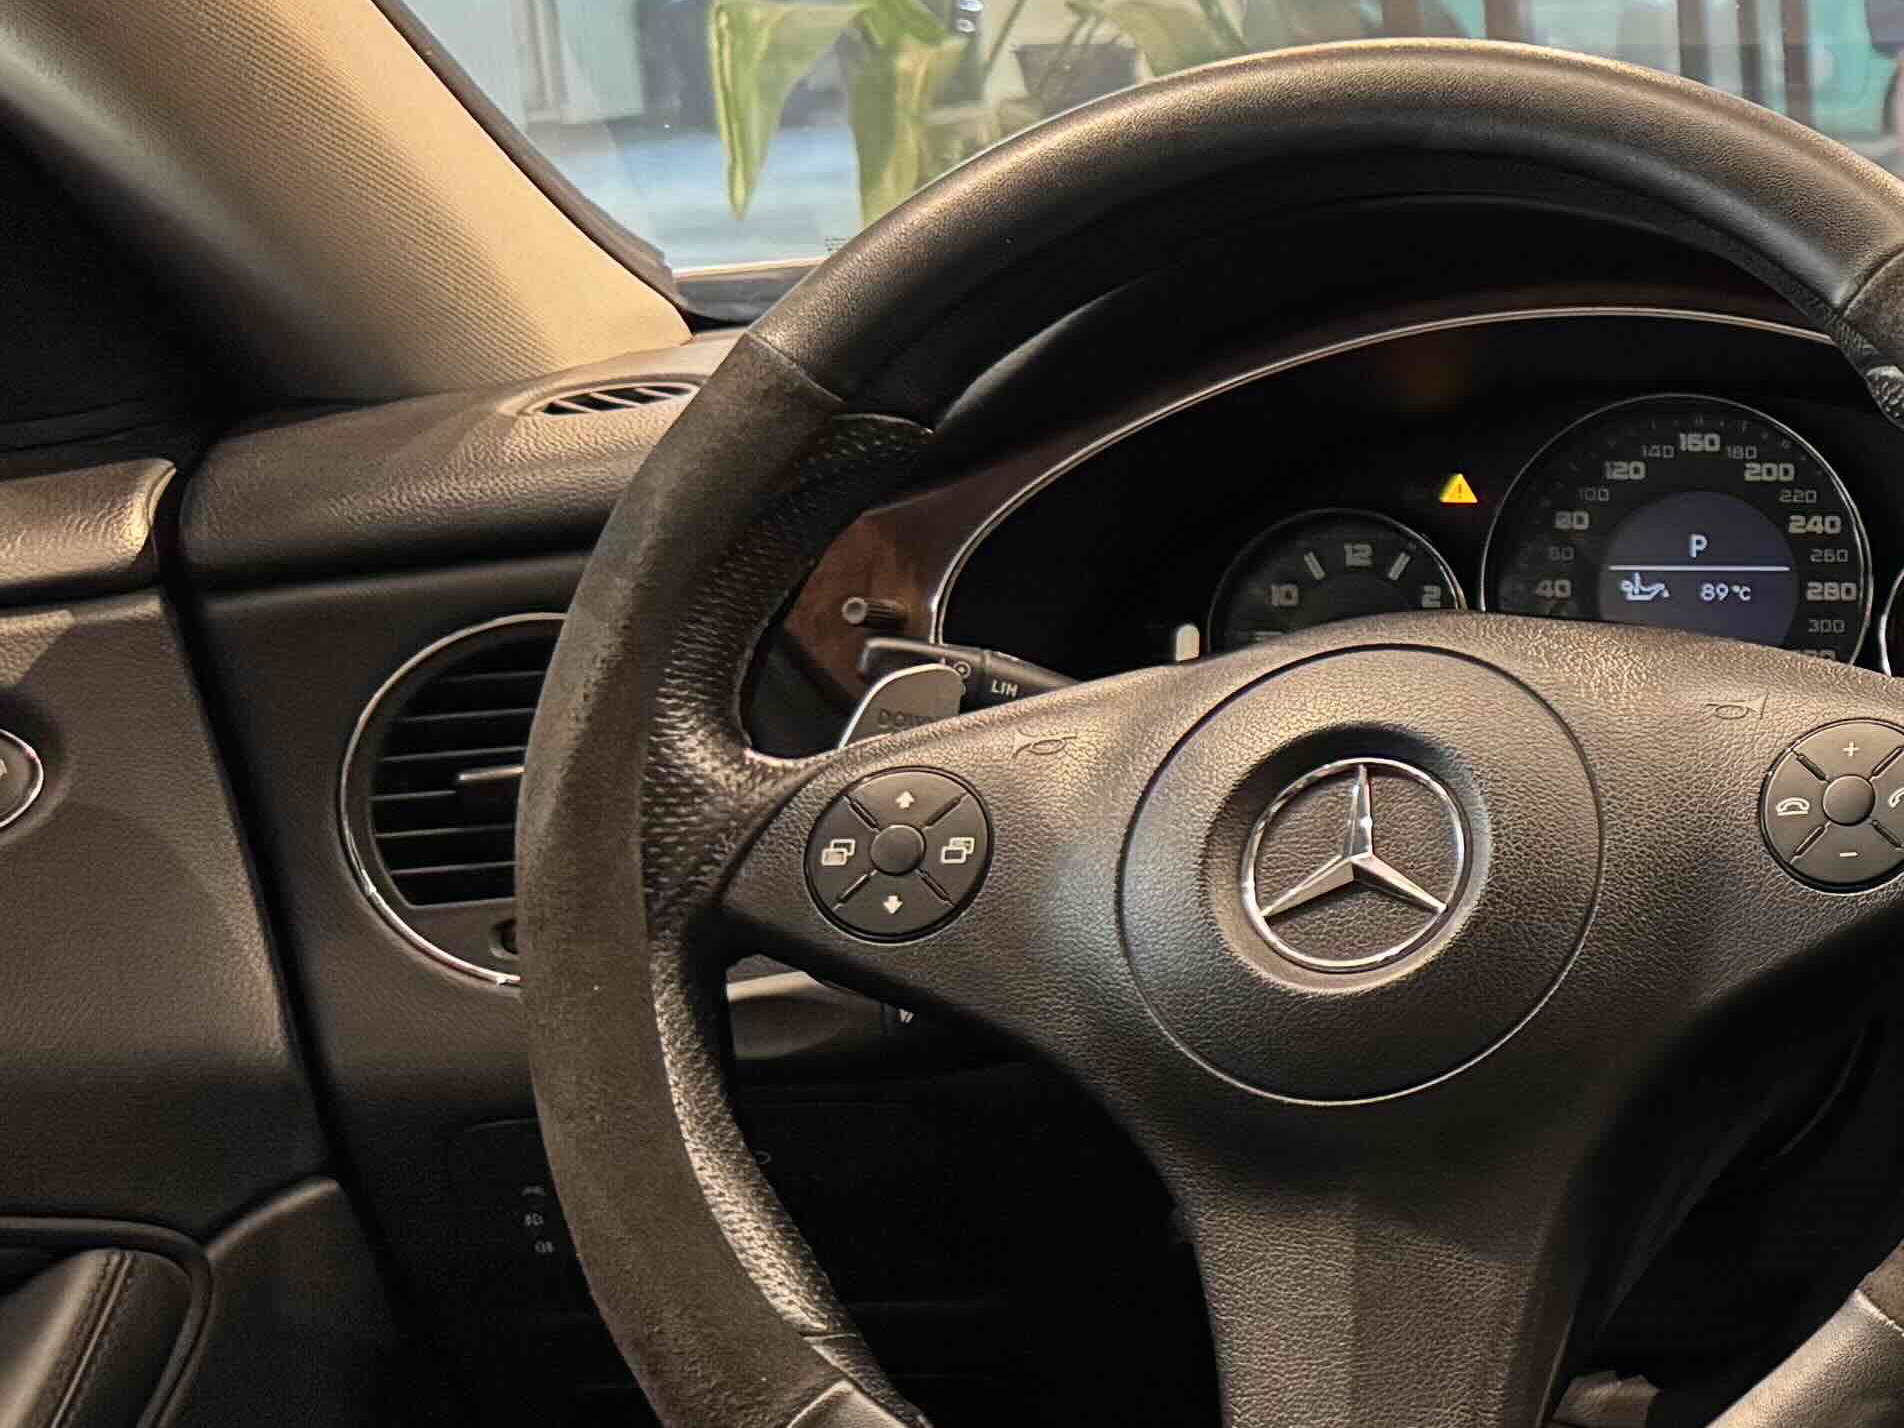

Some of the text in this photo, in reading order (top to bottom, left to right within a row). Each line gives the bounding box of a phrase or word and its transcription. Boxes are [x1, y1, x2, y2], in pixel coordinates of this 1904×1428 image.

[1678, 433, 1722, 453] 160
[1604, 462, 1646, 481] 120
[1743, 463, 1795, 482] 200
[1779, 489, 1818, 504] 220
[1787, 514, 1842, 534] 240
[1343, 543, 1375, 567] 12
[1688, 535, 1708, 559] P
[1809, 548, 1849, 563] 260
[1266, 583, 1300, 608] 10
[1421, 585, 1443, 609] 2
[1535, 579, 1572, 599] 40
[1805, 582, 1857, 602] 280
[1807, 618, 1846, 634] 300
